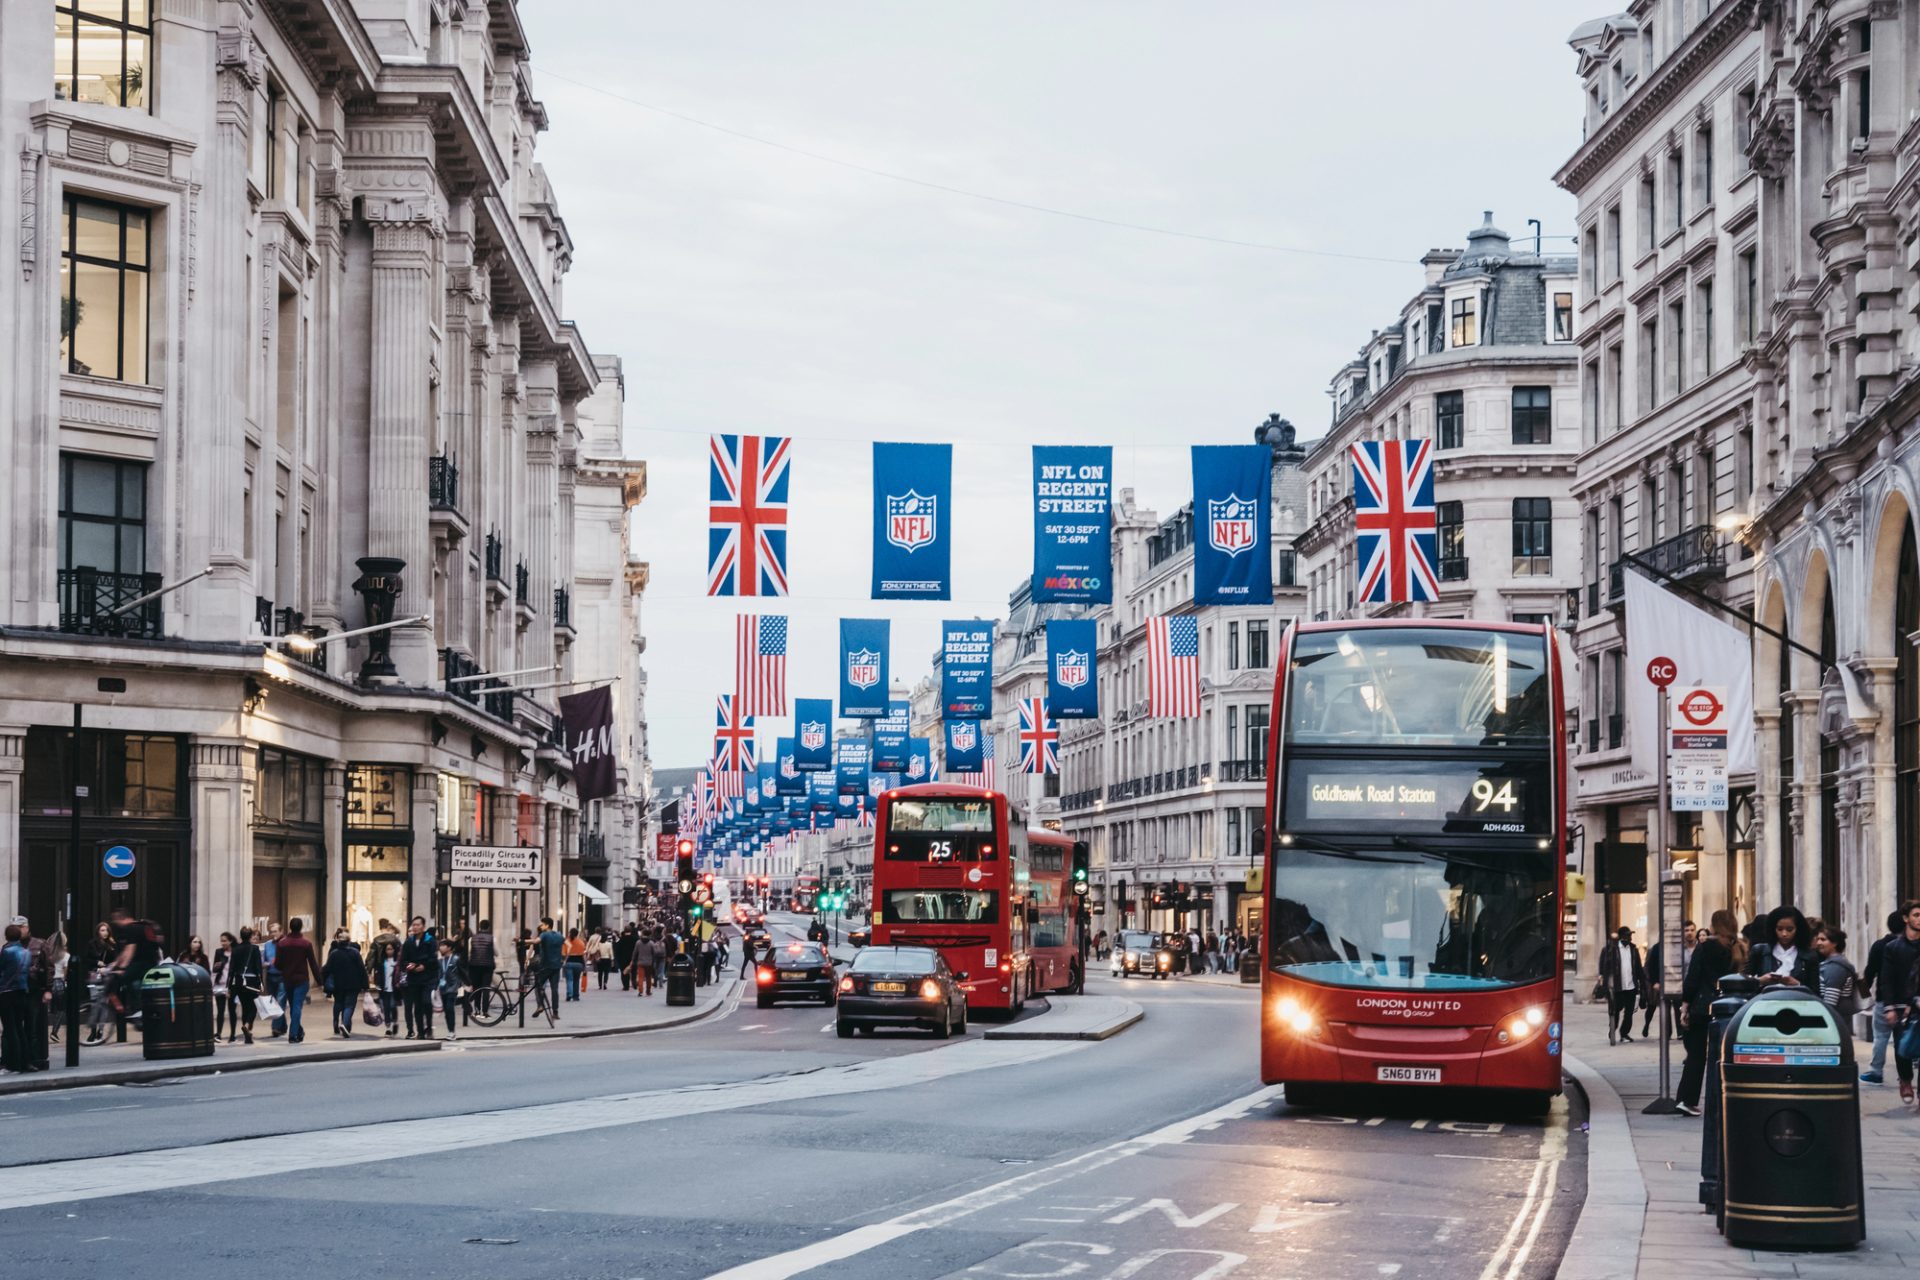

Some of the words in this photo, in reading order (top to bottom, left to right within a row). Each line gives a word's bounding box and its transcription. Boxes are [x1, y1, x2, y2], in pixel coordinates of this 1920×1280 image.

[1042, 466, 1076, 479] NFL
[1079, 466, 1104, 479] ON
[1038, 482, 1108, 496] REGENT
[1039, 499, 1107, 513] STREET
[893, 517, 930, 543] NFL
[1045, 525, 1063, 534] SAT
[1064, 525, 1075, 534] 30
[1076, 525, 1100, 534] SEPT
[1215, 521, 1252, 547] NFL
[1057, 535, 1089, 544] 12-6PM
[947, 632, 970, 642] NFL
[971, 632, 988, 642] ON
[945, 643, 990, 652] REGENT
[945, 653, 990, 663] STREET
[852, 667, 876, 683] NFL
[1061, 667, 1085, 683] NFL
[1651, 666, 1673, 679] RC
[1687, 704, 1699, 712] BUS
[1700, 704, 1714, 712] STOP
[874, 724, 908, 732] STREET
[572, 722, 614, 765] H&M
[804, 733, 822, 746] NFL
[955, 734, 973, 746] NFL
[1312, 784, 1363, 802] Goldhawk
[1367, 784, 1394, 803] Road
[1398, 785, 1436, 803] Station
[1472, 779, 1518, 812] 94
[454, 849, 495, 859] Piccadilly
[498, 850, 526, 859] Circus
[931, 841, 951, 858] 25
[455, 859, 493, 868] Trafalgar
[496, 860, 527, 869] Square
[464, 875, 494, 884] Marble
[496, 876, 517, 884] Arch
[1356, 998, 1407, 1009] LONDON
[1412, 1000, 1461, 1011] UNITED
[1382, 1068, 1411, 1080] SN60
[1415, 1069, 1437, 1080] BYH
